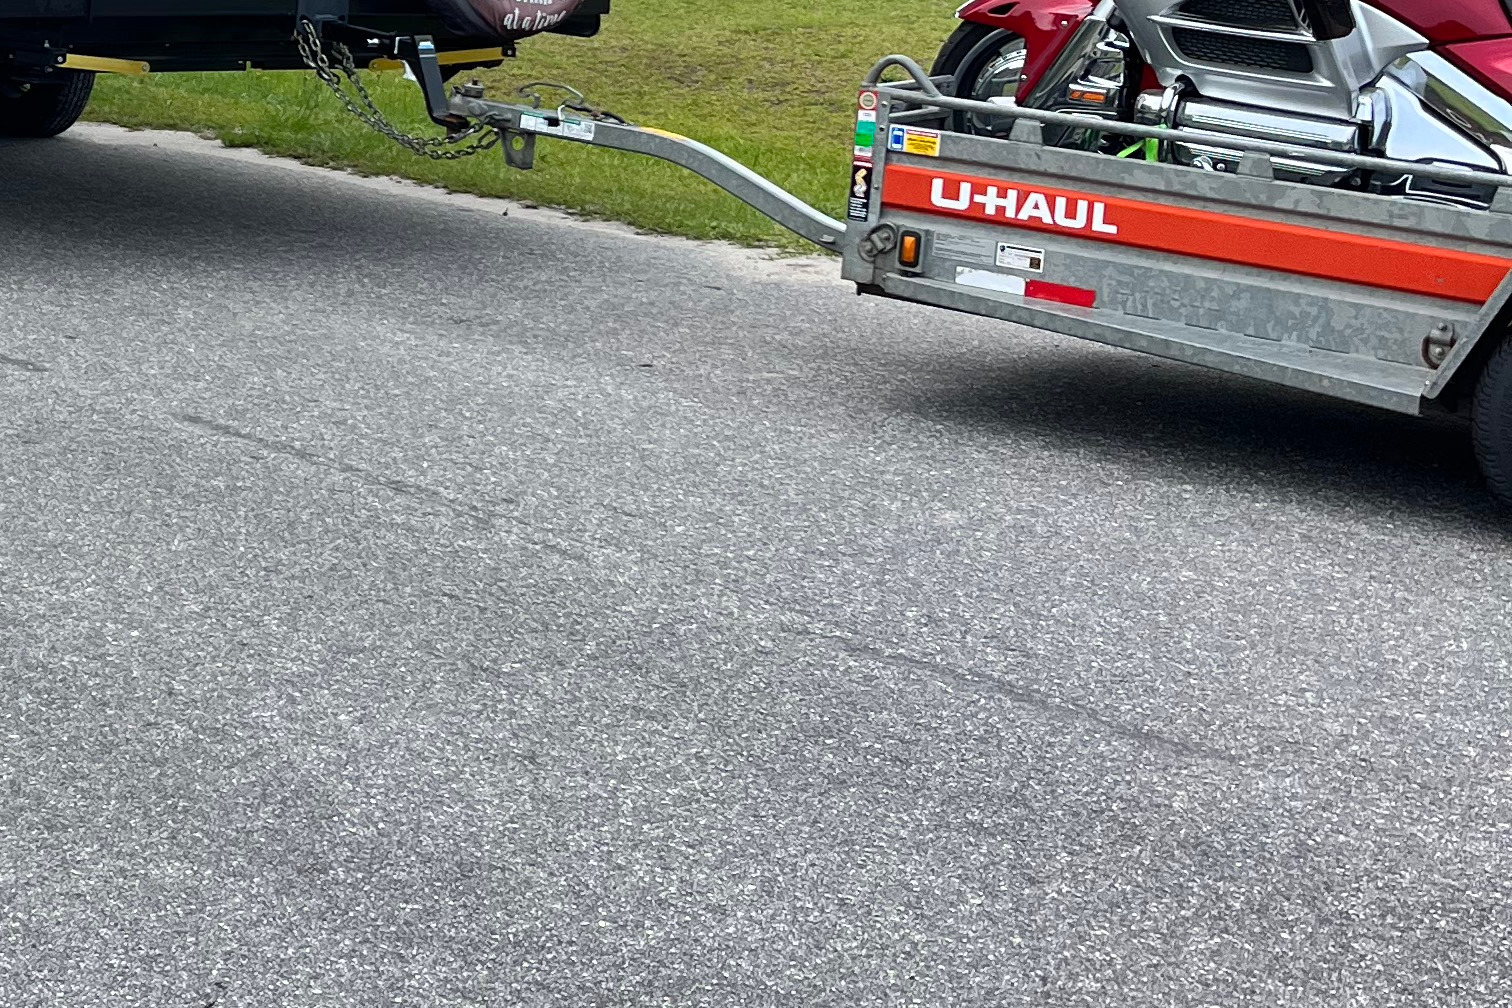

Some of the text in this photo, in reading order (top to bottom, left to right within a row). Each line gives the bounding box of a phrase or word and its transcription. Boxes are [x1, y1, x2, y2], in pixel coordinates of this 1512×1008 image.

[503, 6, 520, 30] at
[521, 16, 532, 31] a
[930, 177, 1118, 234] U-HAUL
